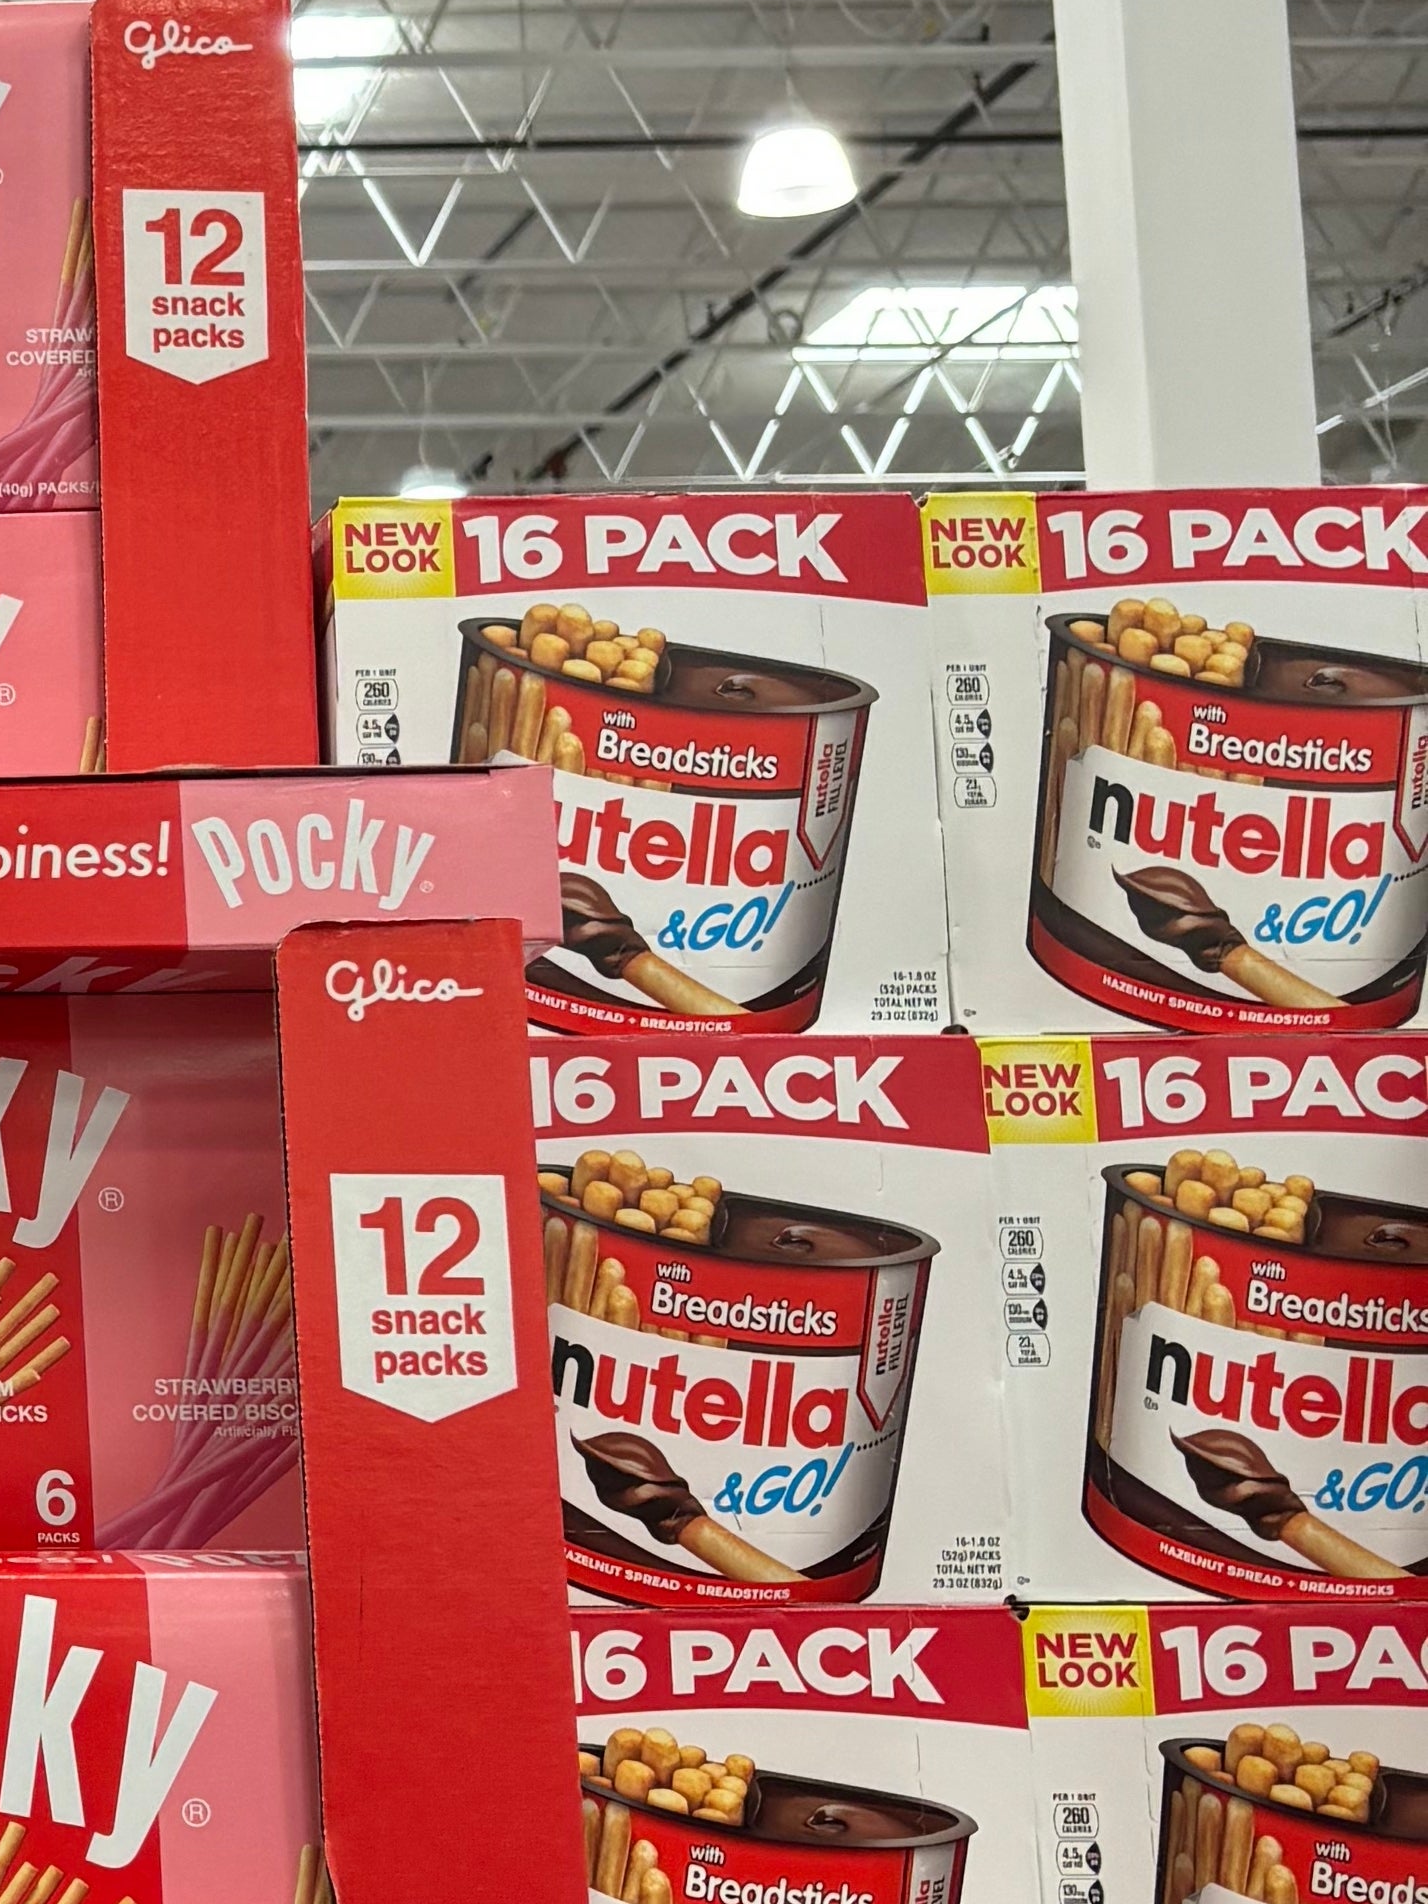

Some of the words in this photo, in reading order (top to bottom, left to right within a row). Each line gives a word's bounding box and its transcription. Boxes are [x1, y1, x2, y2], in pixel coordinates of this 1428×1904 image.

[124, 20, 252, 70] Glico
[345, 522, 441, 546] NEW
[462, 514, 563, 584] 16
[586, 513, 849, 584] PACK
[345, 549, 441, 574] LOOK
[931, 517, 1026, 542] NEW
[1047, 510, 1148, 580] 16
[1170, 506, 1428, 572] PACK
[932, 545, 1026, 569] LOOK
[1189, 723, 1372, 773] Breadsticks
[1194, 706, 1227, 723] with
[597, 728, 778, 780] Breadsticks
[191, 798, 436, 910] Pocky
[1089, 775, 1385, 881] nutella
[1254, 873, 1393, 946] &GO!
[325, 958, 483, 1021] Glico
[1102, 974, 1166, 1006] HAZELNUT
[1168, 997, 1223, 1019] SPREAD
[1239, 1010, 1331, 1027] BREADSTICKS
[638, 1055, 910, 1130] PACK
[1103, 1056, 1207, 1128] 16
[360, 1197, 485, 1296] 12
[371, 1304, 487, 1335] snack
[373, 1345, 488, 1383] packs
[552, 1334, 849, 1448] nutella
[35, 1471, 76, 1526] 6
[671, 1627, 945, 1704] PACK
[1160, 1626, 1266, 1701] 16
